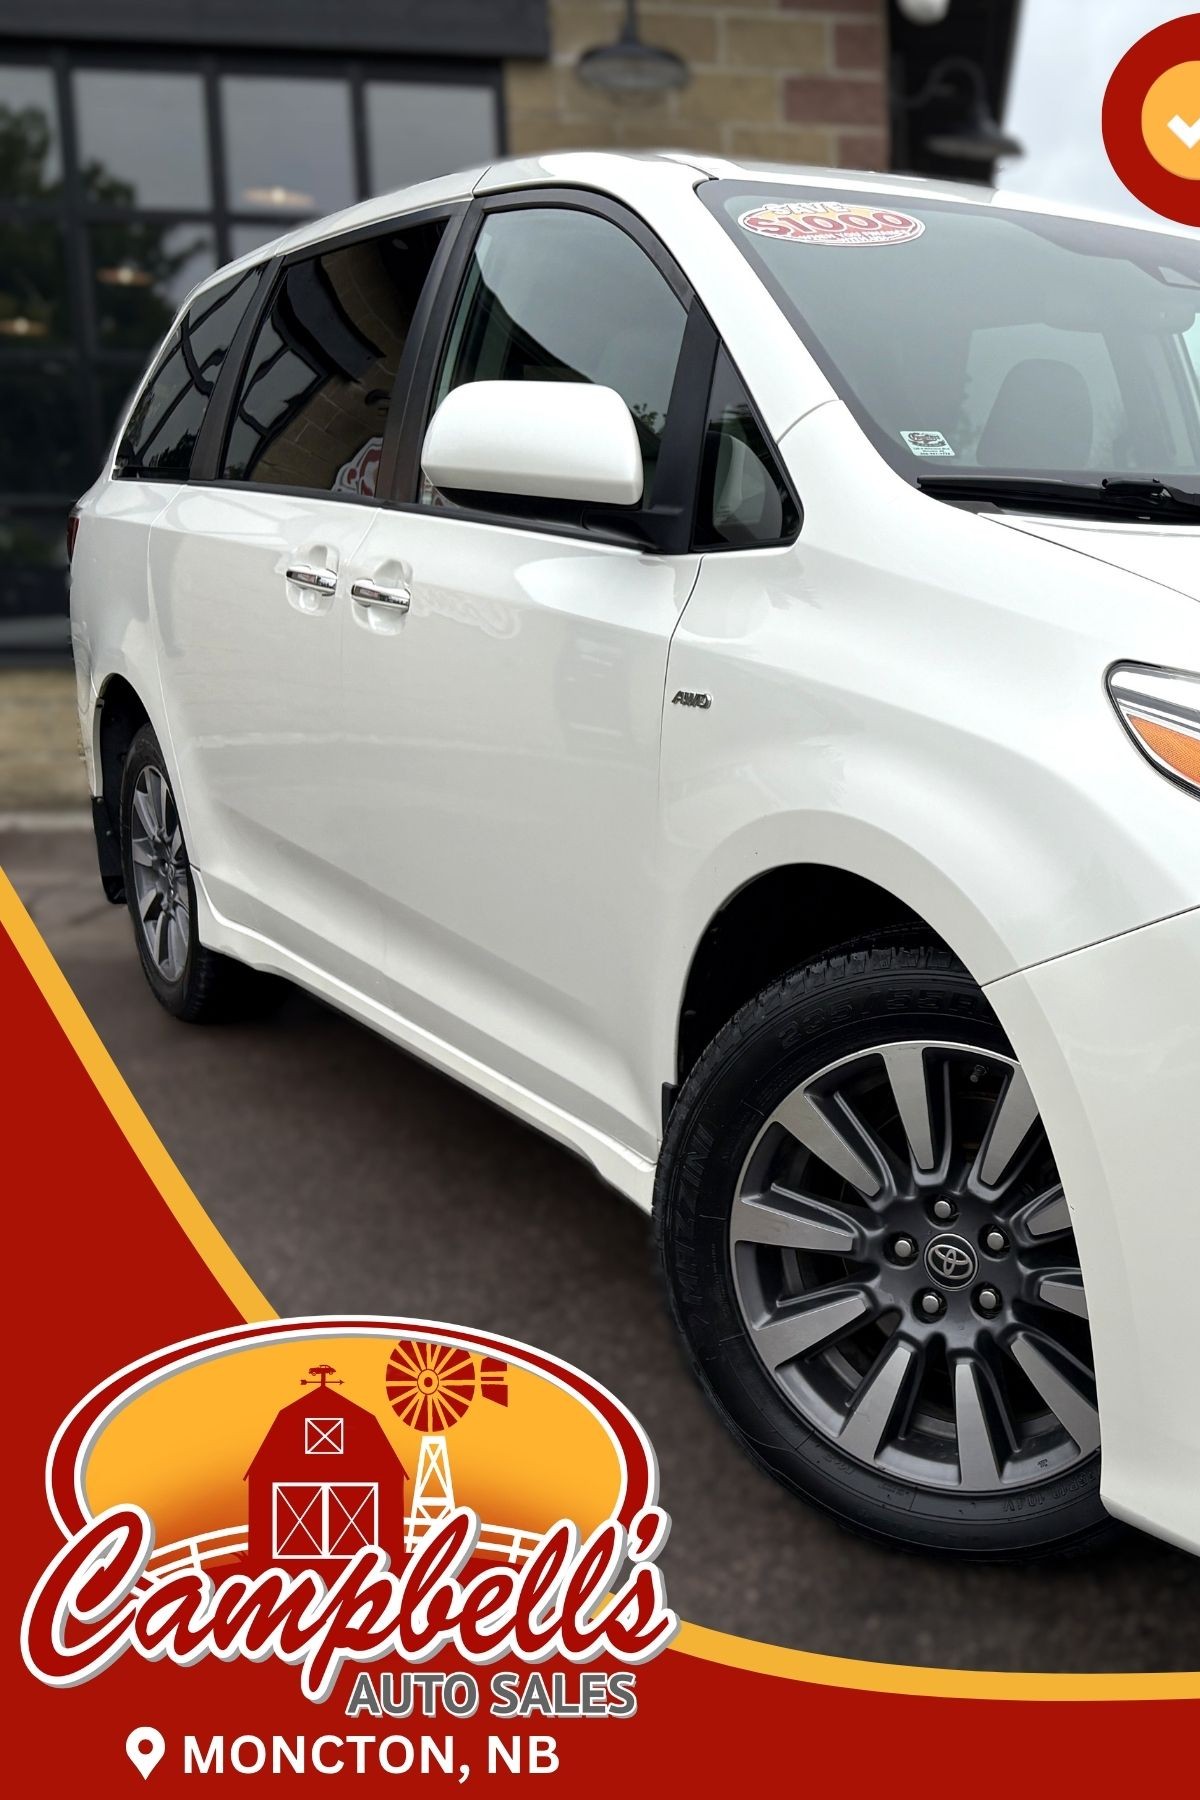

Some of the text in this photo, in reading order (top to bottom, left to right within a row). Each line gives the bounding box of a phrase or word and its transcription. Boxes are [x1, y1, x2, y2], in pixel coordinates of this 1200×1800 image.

[746, 211, 913, 237] $1000
[671, 690, 712, 709] AWD
[778, 987, 991, 1047] 235/55R
